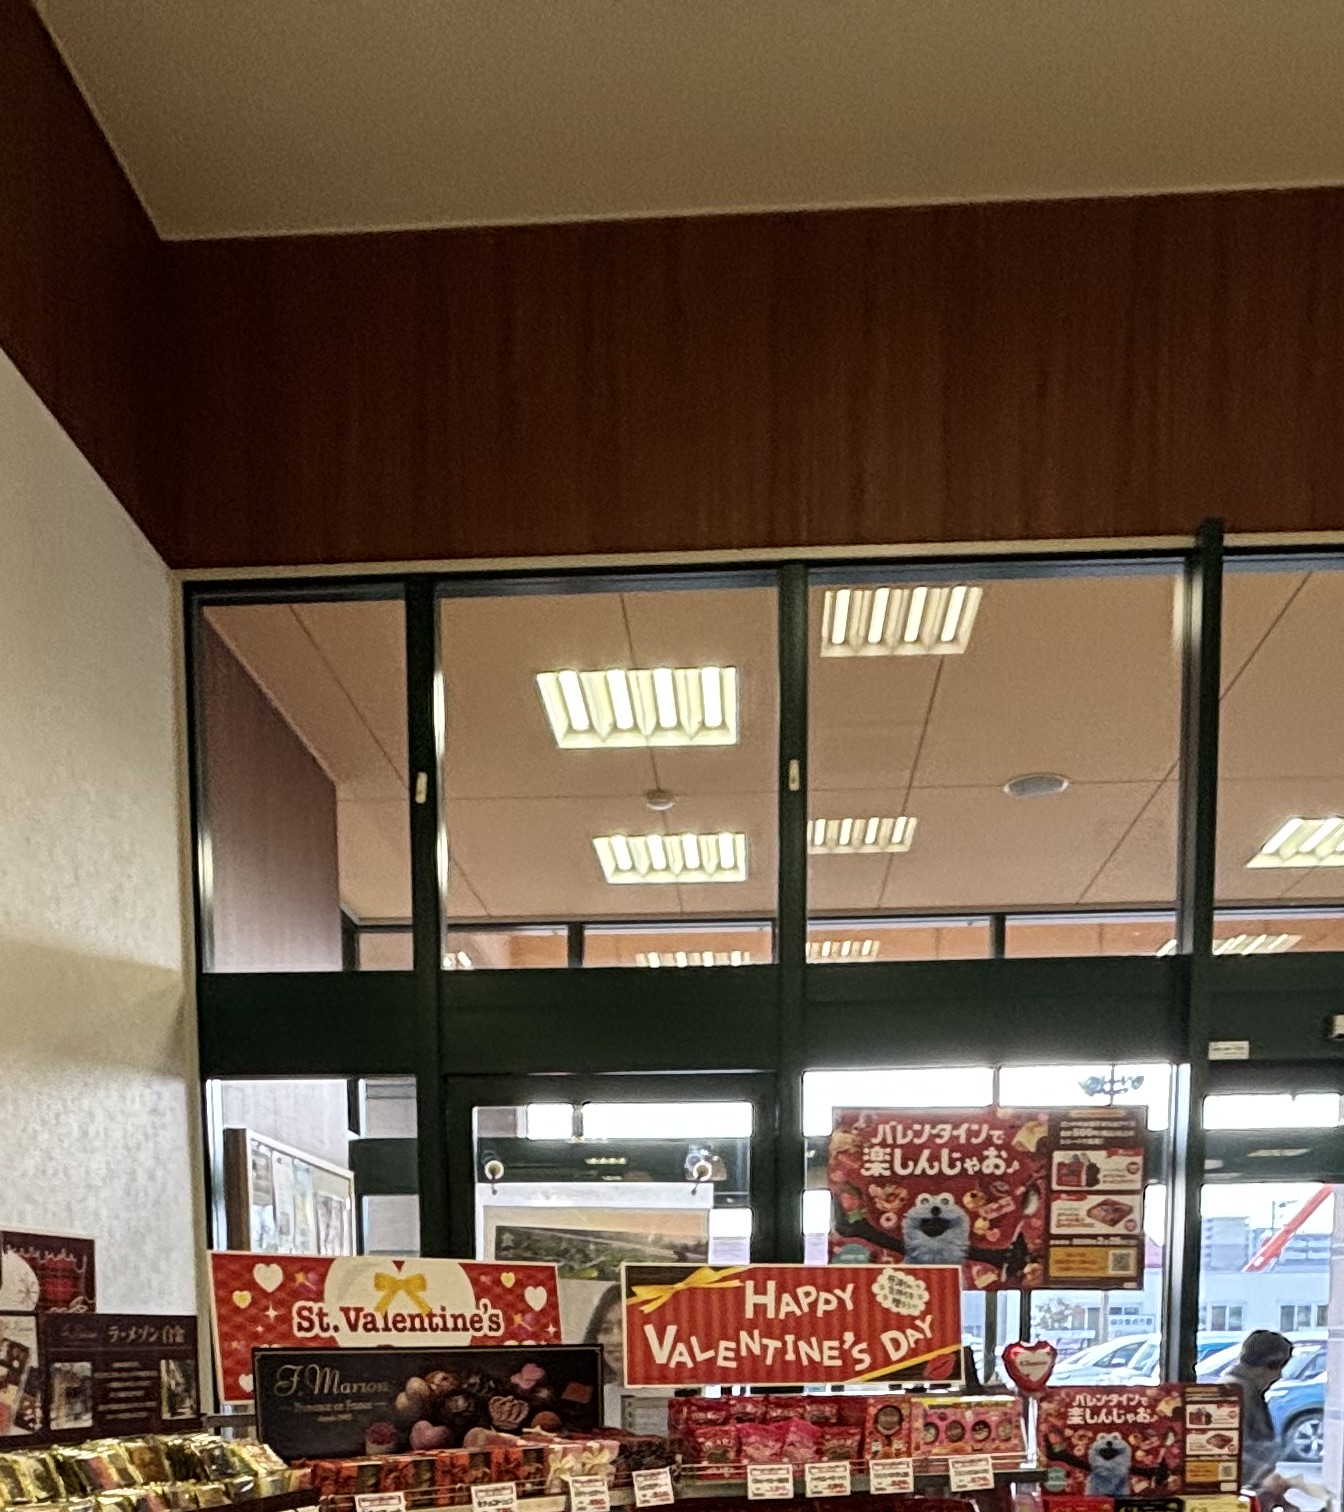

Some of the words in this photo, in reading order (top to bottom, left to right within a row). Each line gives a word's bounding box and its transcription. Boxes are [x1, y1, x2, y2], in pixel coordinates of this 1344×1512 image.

[870, 1121, 1004, 1146] バレンタインで
[745, 1280, 855, 1320] HAPPY
[643, 1323, 872, 1372] VALENTINE'S
[879, 1313, 936, 1362] DAY
[1071, 1393, 1148, 1408] バレンタインで
